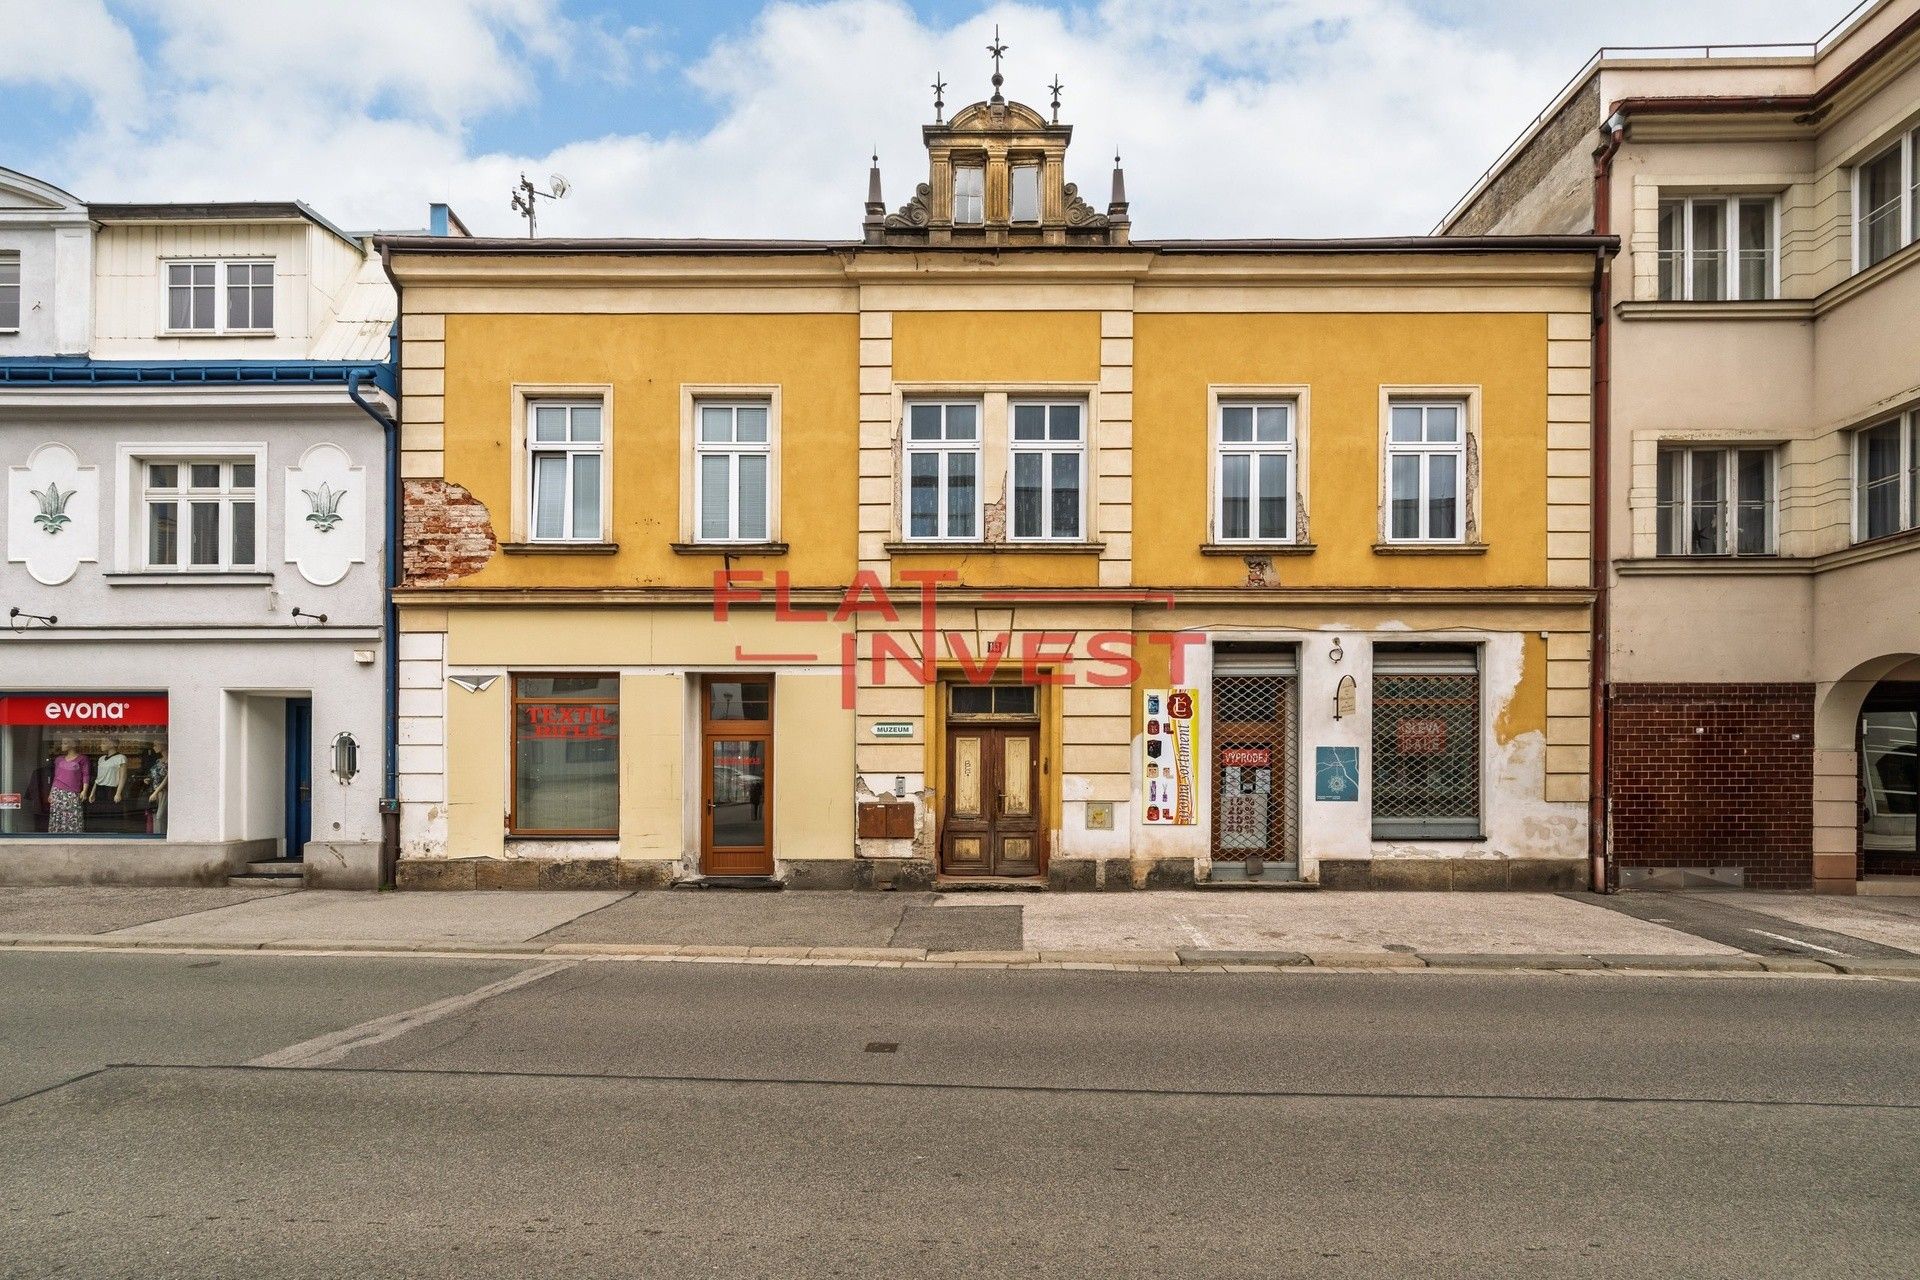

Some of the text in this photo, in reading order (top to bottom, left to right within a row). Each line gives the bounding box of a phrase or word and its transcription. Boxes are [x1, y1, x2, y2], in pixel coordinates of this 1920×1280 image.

[45, 702, 124, 719] evona
[525, 705, 614, 724] TEXTIL
[1178, 723, 1190, 780] sortiment
